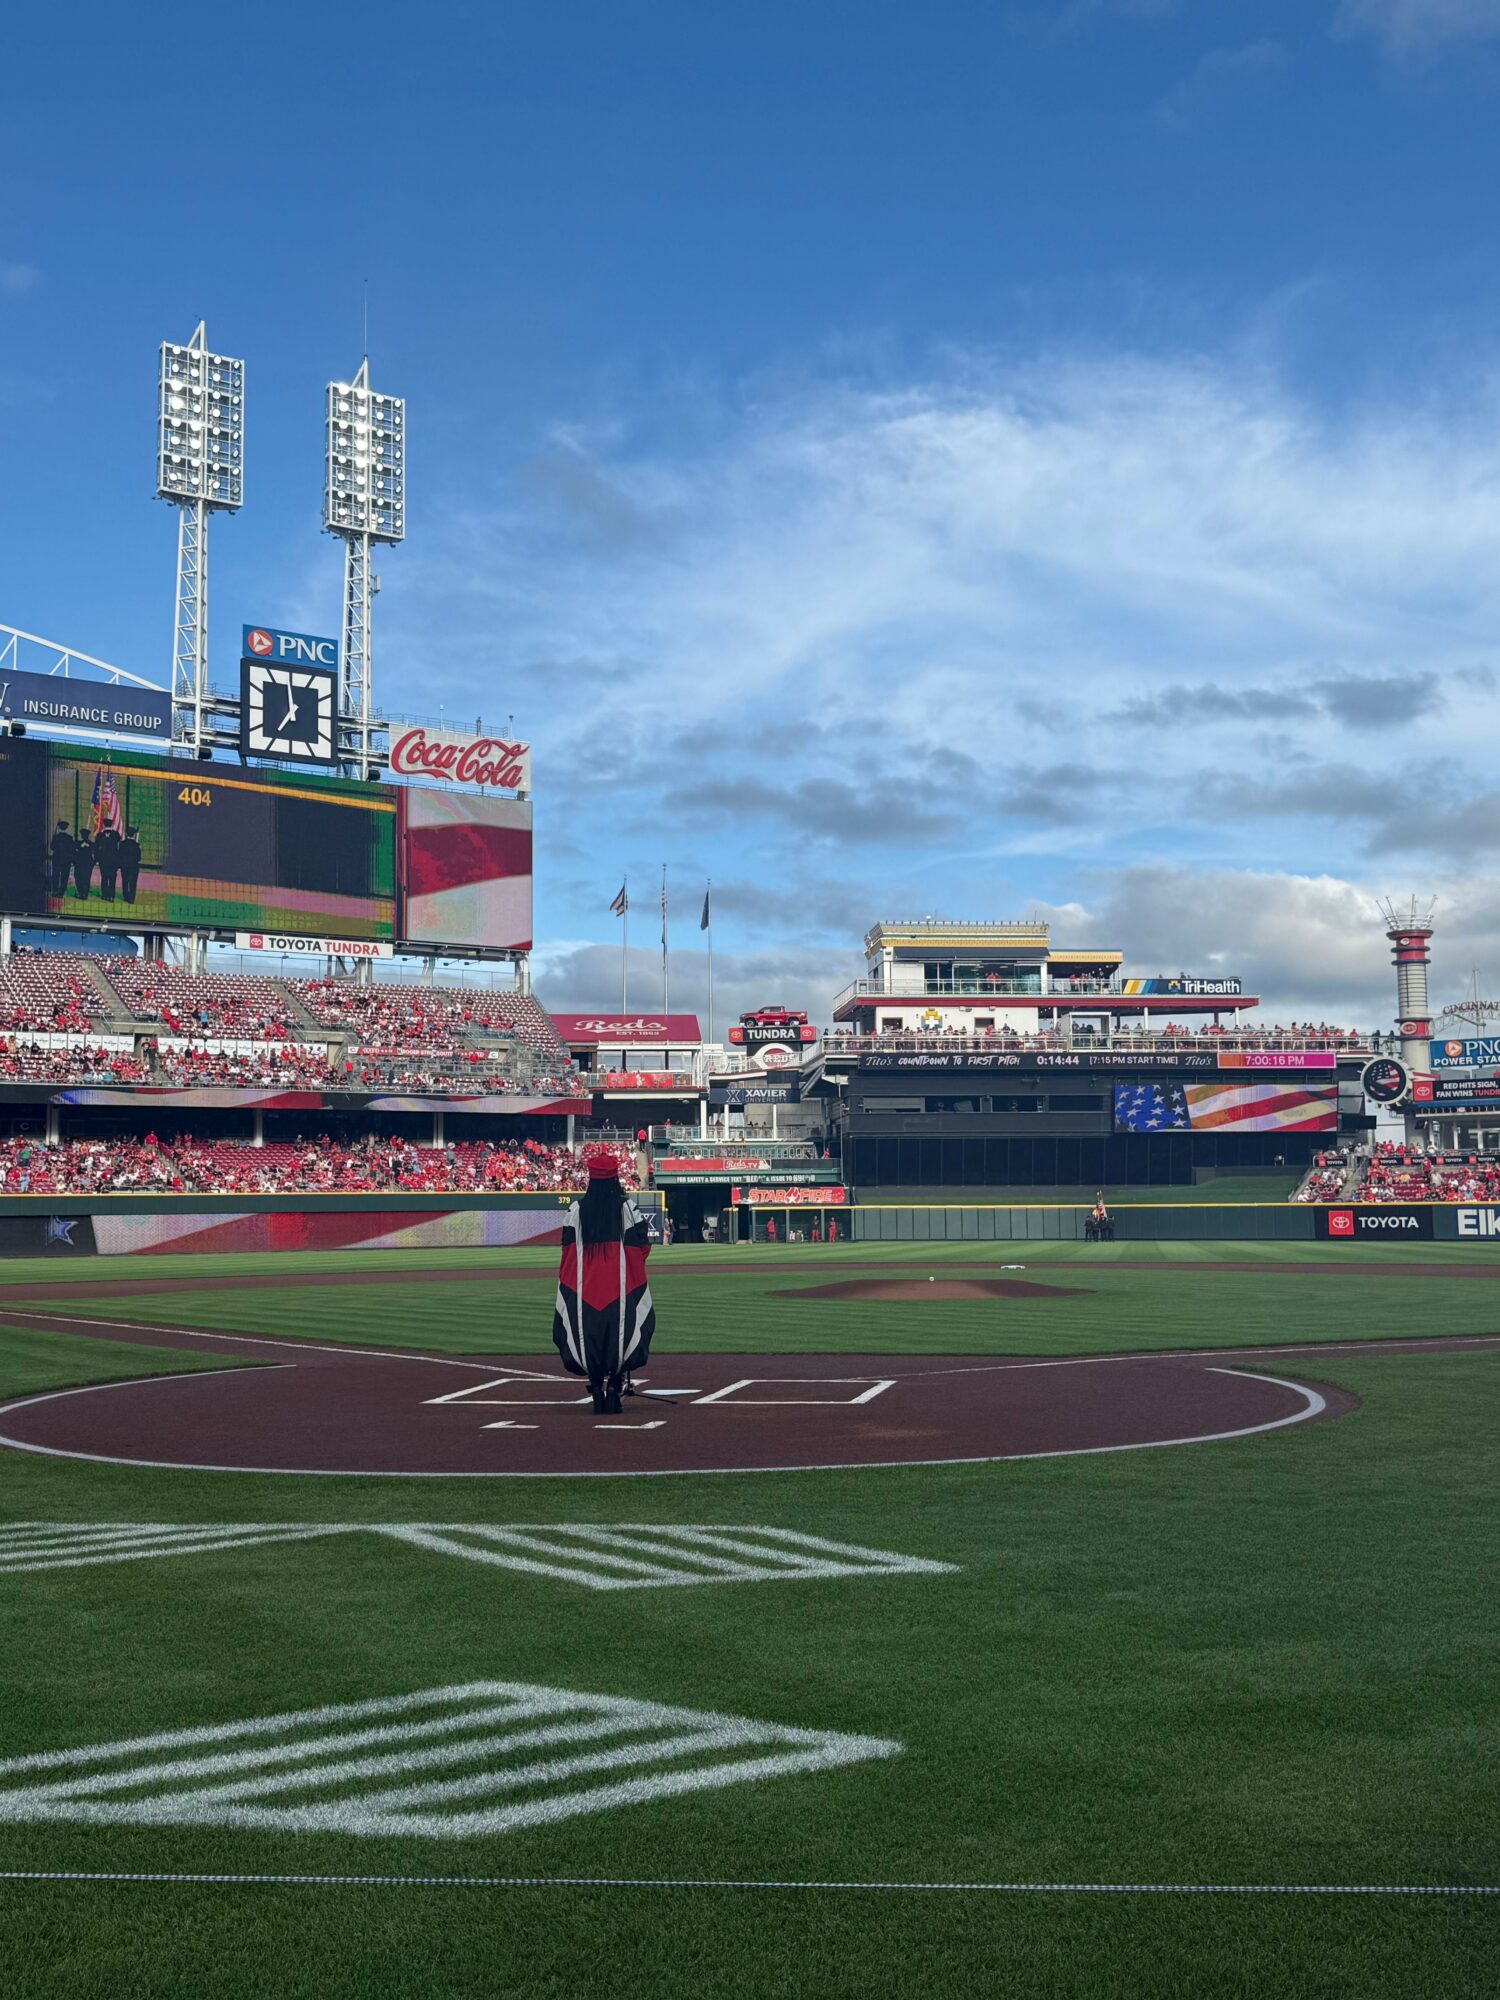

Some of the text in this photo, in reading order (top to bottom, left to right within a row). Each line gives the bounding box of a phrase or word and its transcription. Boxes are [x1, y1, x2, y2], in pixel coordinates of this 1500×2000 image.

[276, 634, 335, 665] PNC
[24, 700, 162, 729] INSURANCE GROUP
[390, 729, 530, 788] Coca-Cola
[177, 787, 212, 807] 404
[268, 937, 380, 956] TOYOTA TUNDRA
[1182, 980, 1240, 993] TriHealth
[572, 1019, 668, 1034] Reds
[747, 1029, 796, 1039] TUNDRA
[866, 1056, 893, 1066] Tito's
[898, 1055, 949, 1065] COUNTDOWN
[952, 1055, 964, 1065] TO
[968, 1055, 994, 1066] FIRST
[997, 1055, 1020, 1065] PITCH
[1036, 1056, 1080, 1065] 0:14:44
[1112, 1056, 1125, 1064] PM
[1127, 1056, 1155, 1064] START
[1184, 1056, 1212, 1066] Tito's
[1245, 1056, 1304, 1065] 7:00:16 PM
[1433, 1057, 1473, 1066] POWER
[1443, 1082, 1458, 1090] RED
[1477, 1081, 1499, 1089] SIGN,
[745, 1089, 787, 1097] XAVIER
[558, 1196, 571, 1204] 379
[749, 1188, 787, 1203] STAR
[799, 1188, 832, 1203] FIRE
[1358, 1216, 1419, 1228] TOYOTA
